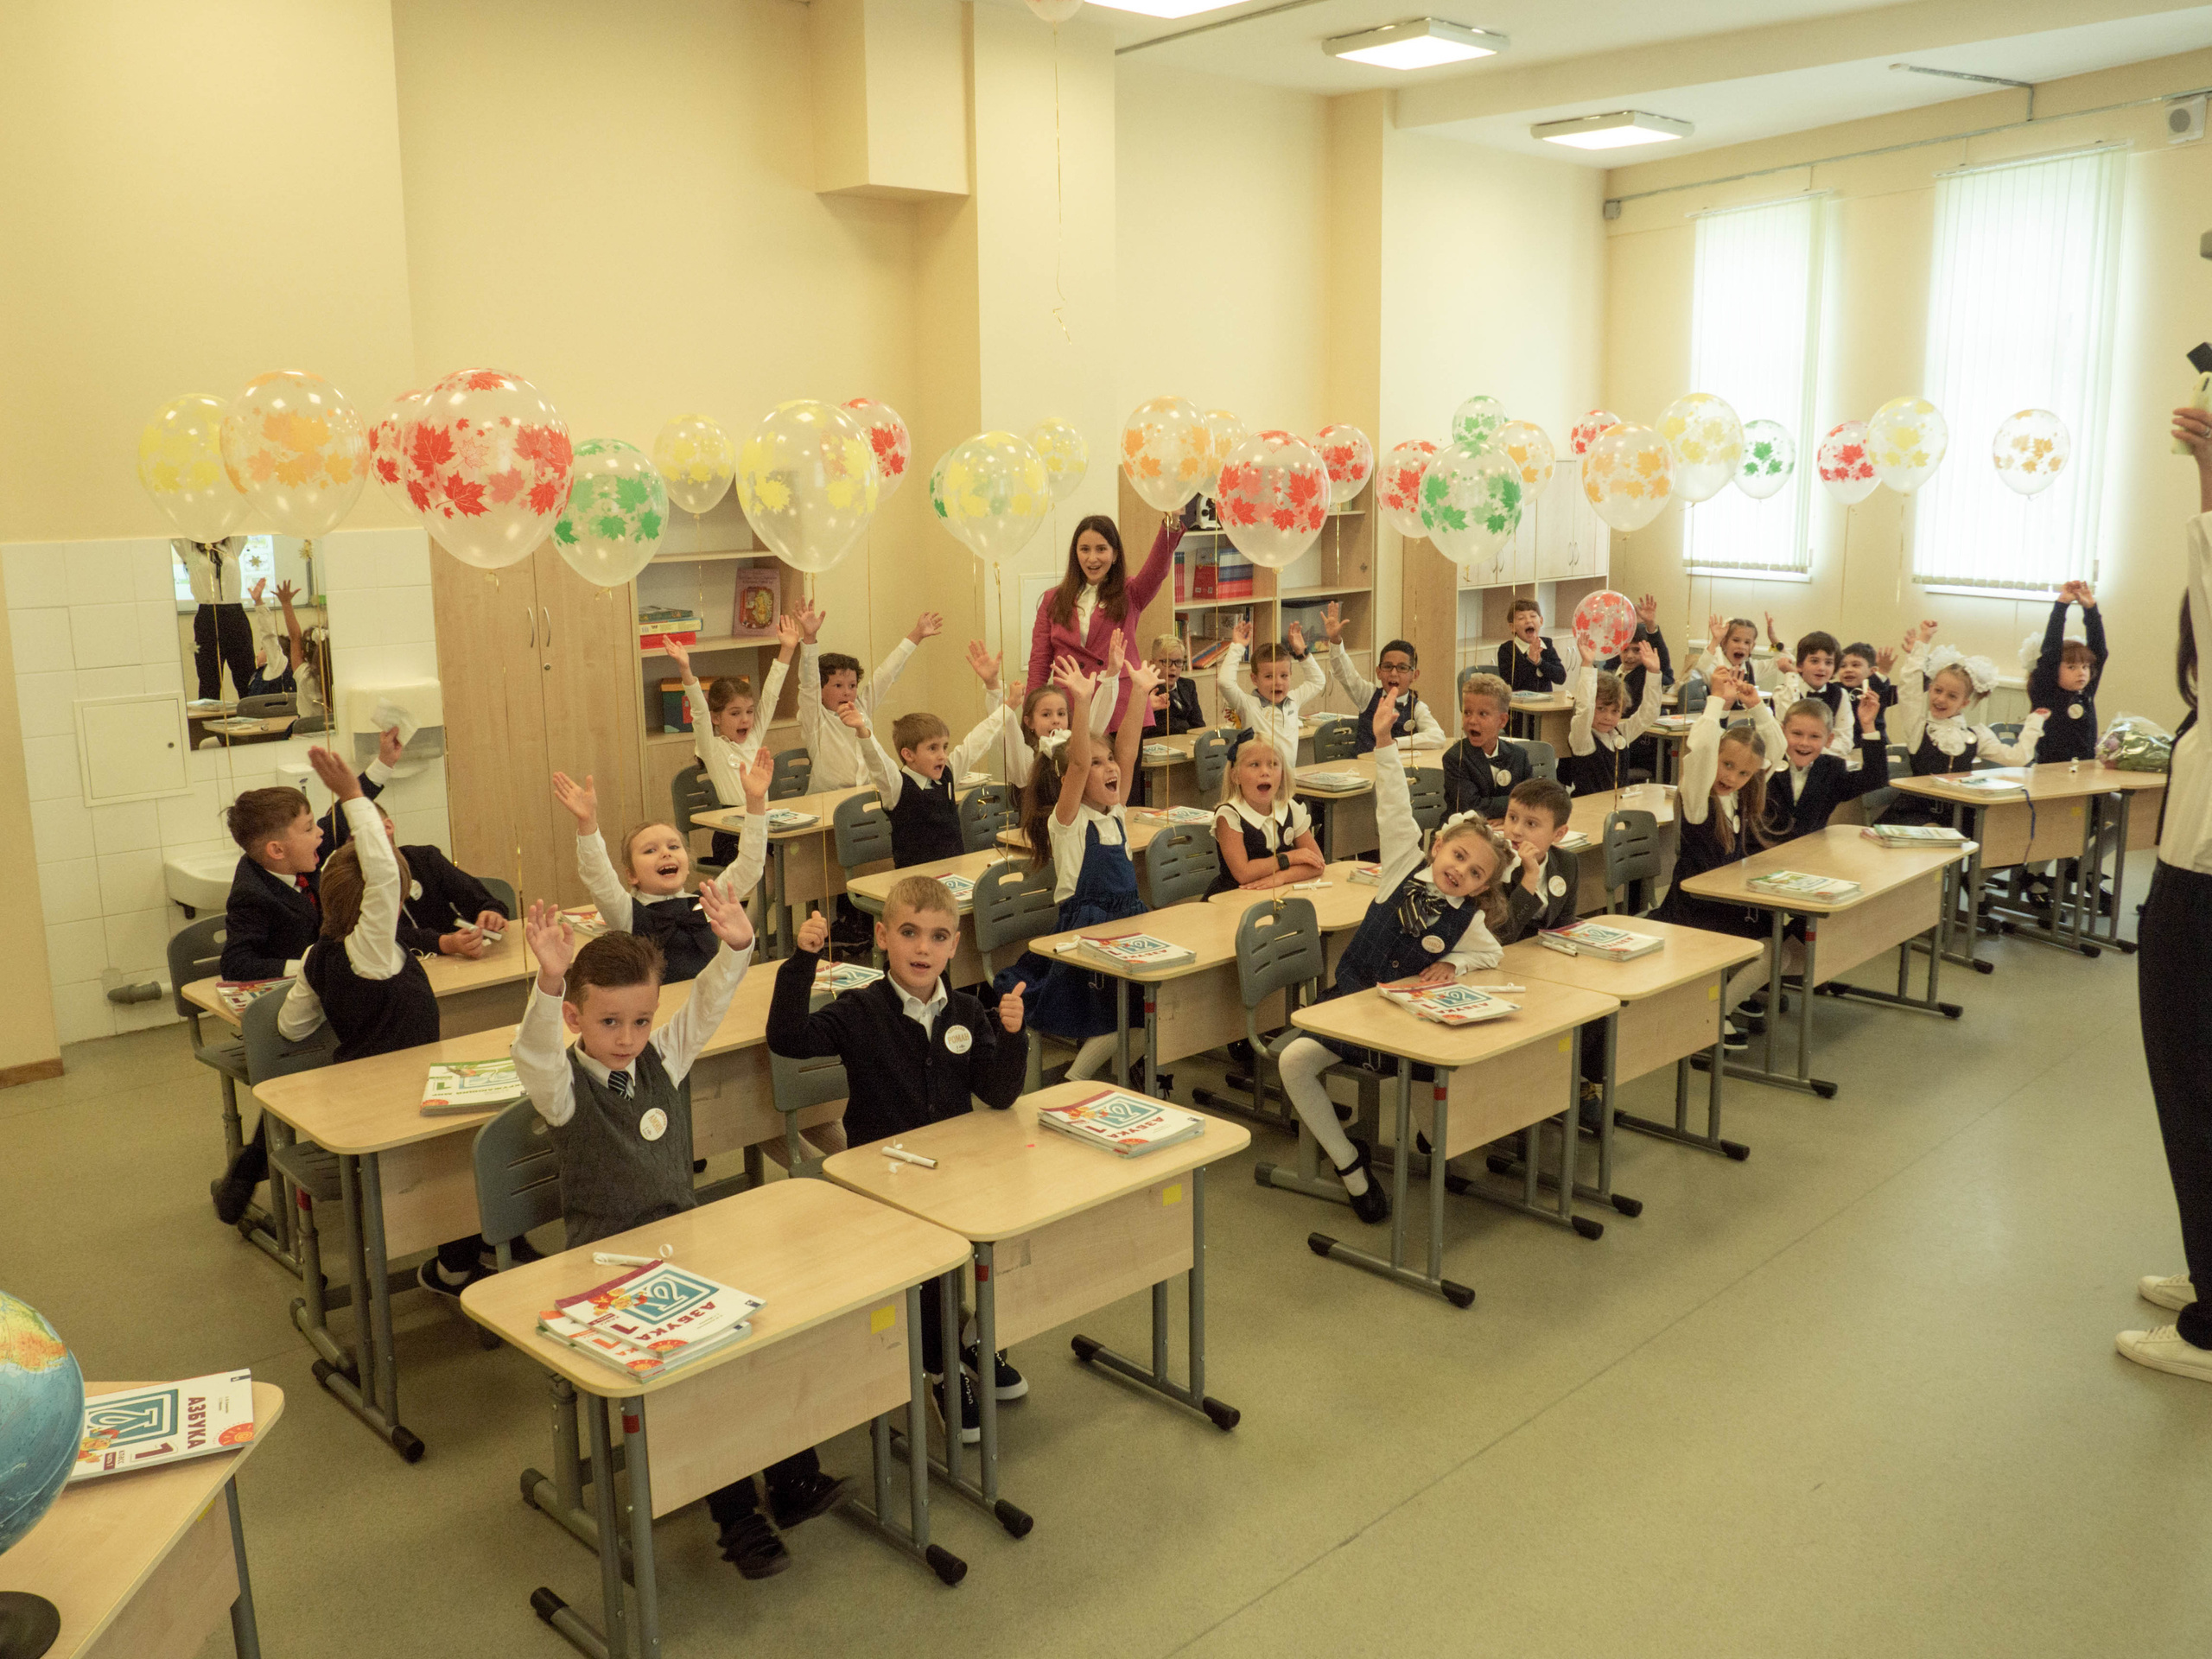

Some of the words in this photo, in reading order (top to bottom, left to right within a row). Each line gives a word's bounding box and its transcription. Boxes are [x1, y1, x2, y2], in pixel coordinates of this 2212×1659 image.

[947, 1033, 969, 1044] РОМАН
[1084, 1125, 1107, 1134] 1
[1106, 1116, 1165, 1139] АЗБУКА
[609, 1324, 639, 1335] 1
[634, 1301, 716, 1342] АЗБУКА
[187, 1396, 207, 1449] АЗБУКА
[135, 1442, 175, 1459] 1
